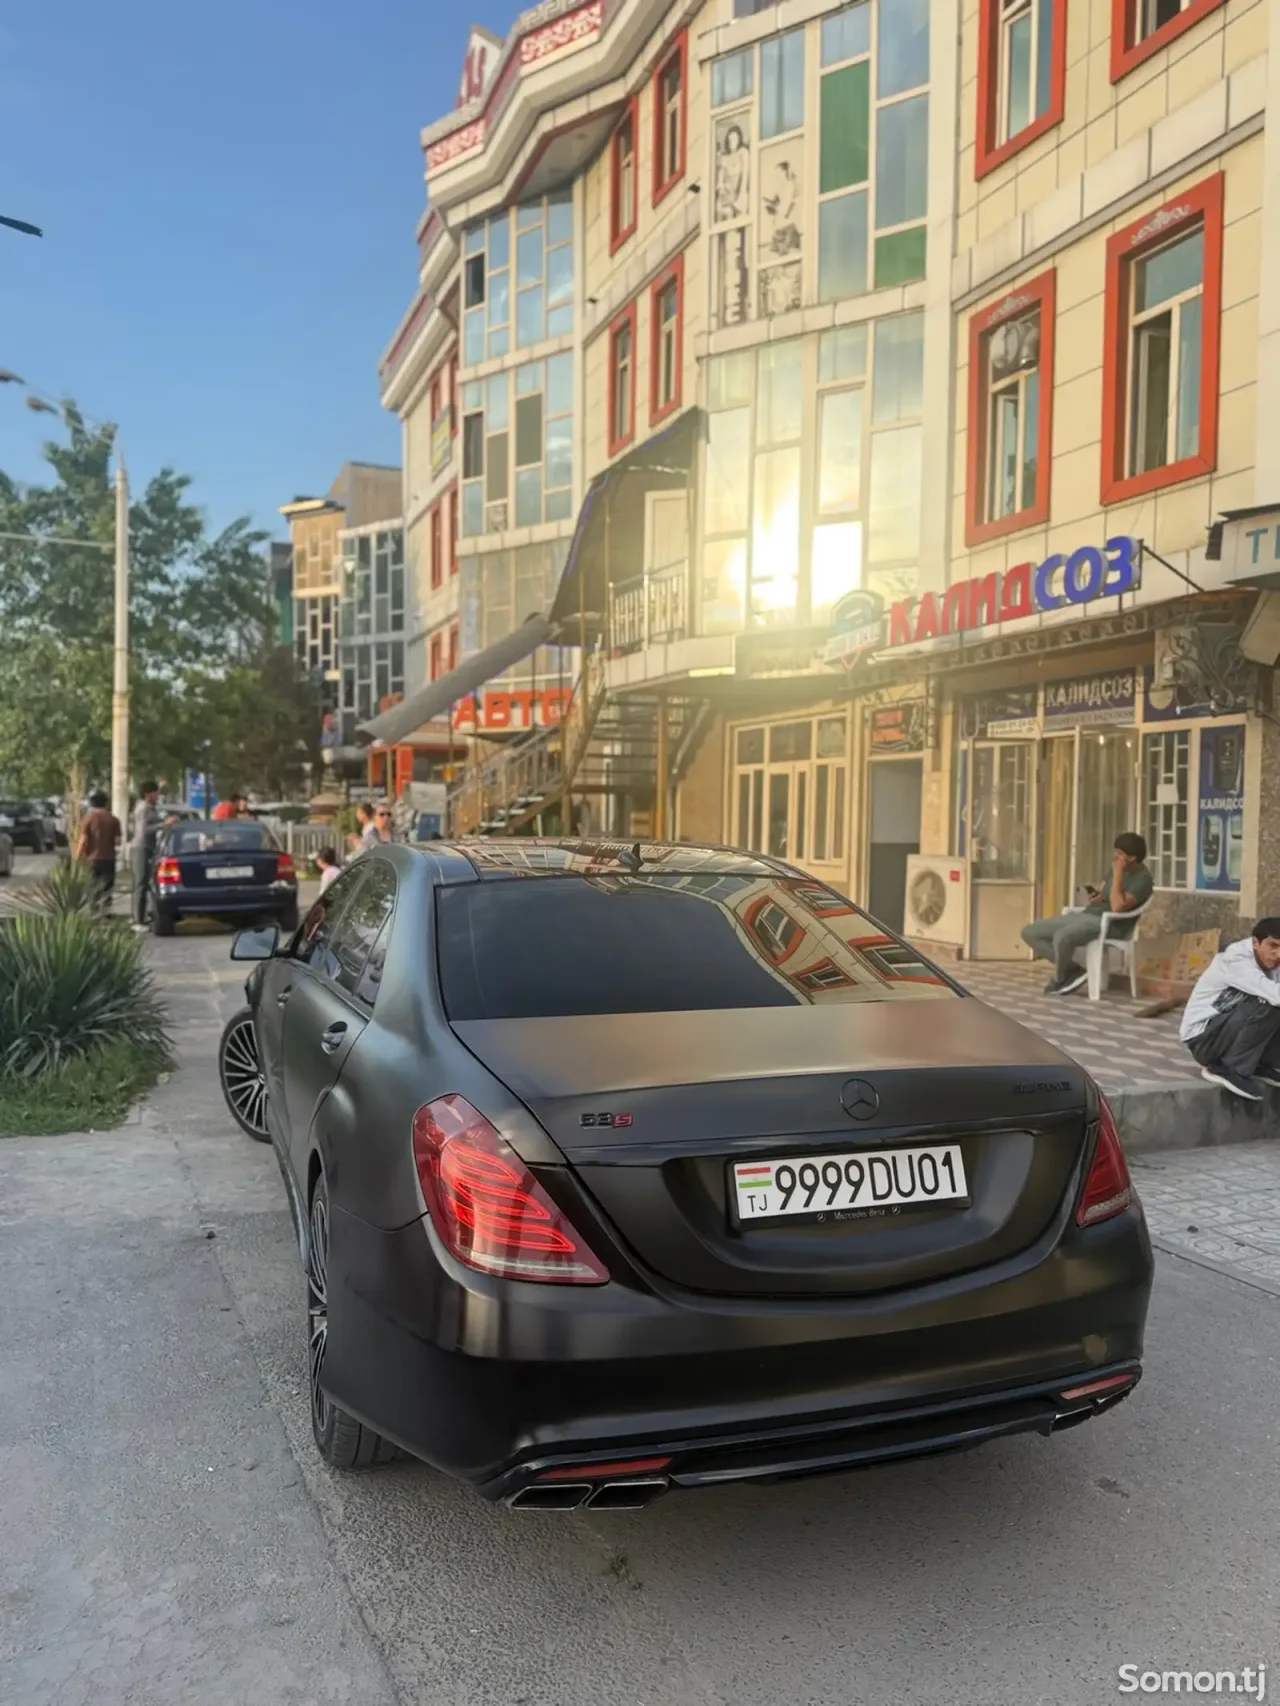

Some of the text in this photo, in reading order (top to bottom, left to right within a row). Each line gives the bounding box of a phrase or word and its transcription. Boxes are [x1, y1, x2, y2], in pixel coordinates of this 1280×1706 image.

[890, 536, 1139, 645] КАЛИДСОЗ
[1046, 674, 1133, 707] КАЛИДСОЗ
[747, 1194, 768, 1213] TJ
[774, 1151, 957, 1211] 9999DU01
